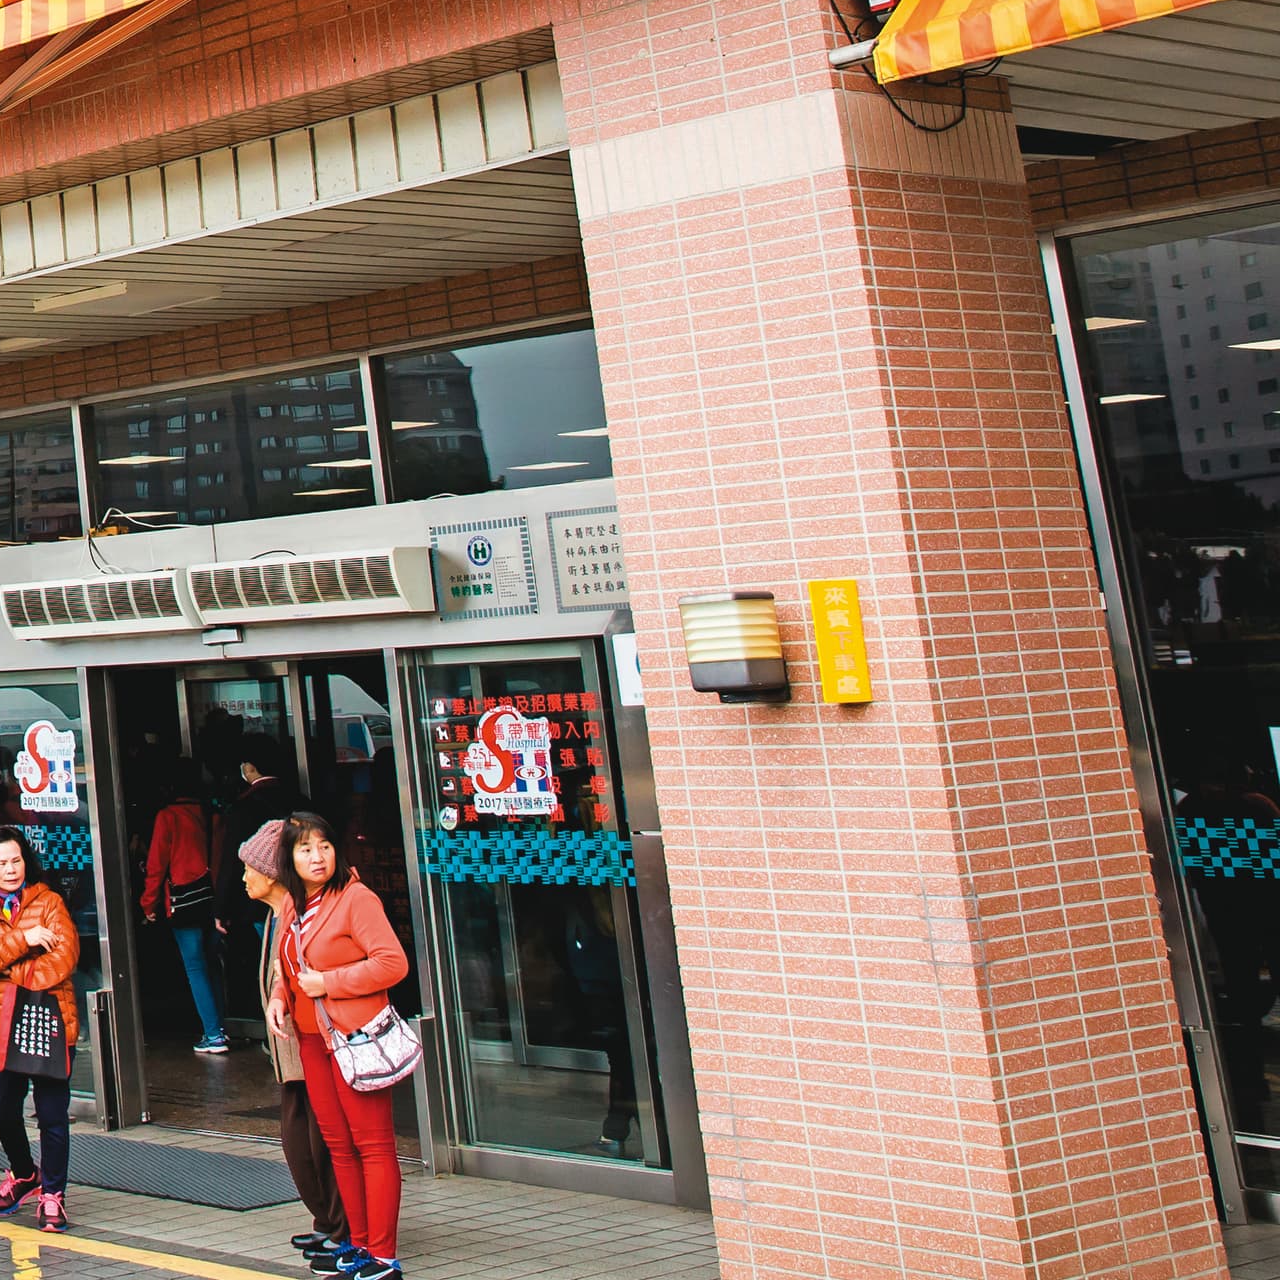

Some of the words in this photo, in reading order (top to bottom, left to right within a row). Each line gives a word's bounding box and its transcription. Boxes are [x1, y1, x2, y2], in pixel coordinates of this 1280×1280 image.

[450, 583, 494, 598] 特約醫院
[506, 737, 547, 752] Hospital
[472, 747, 484, 760] 25
